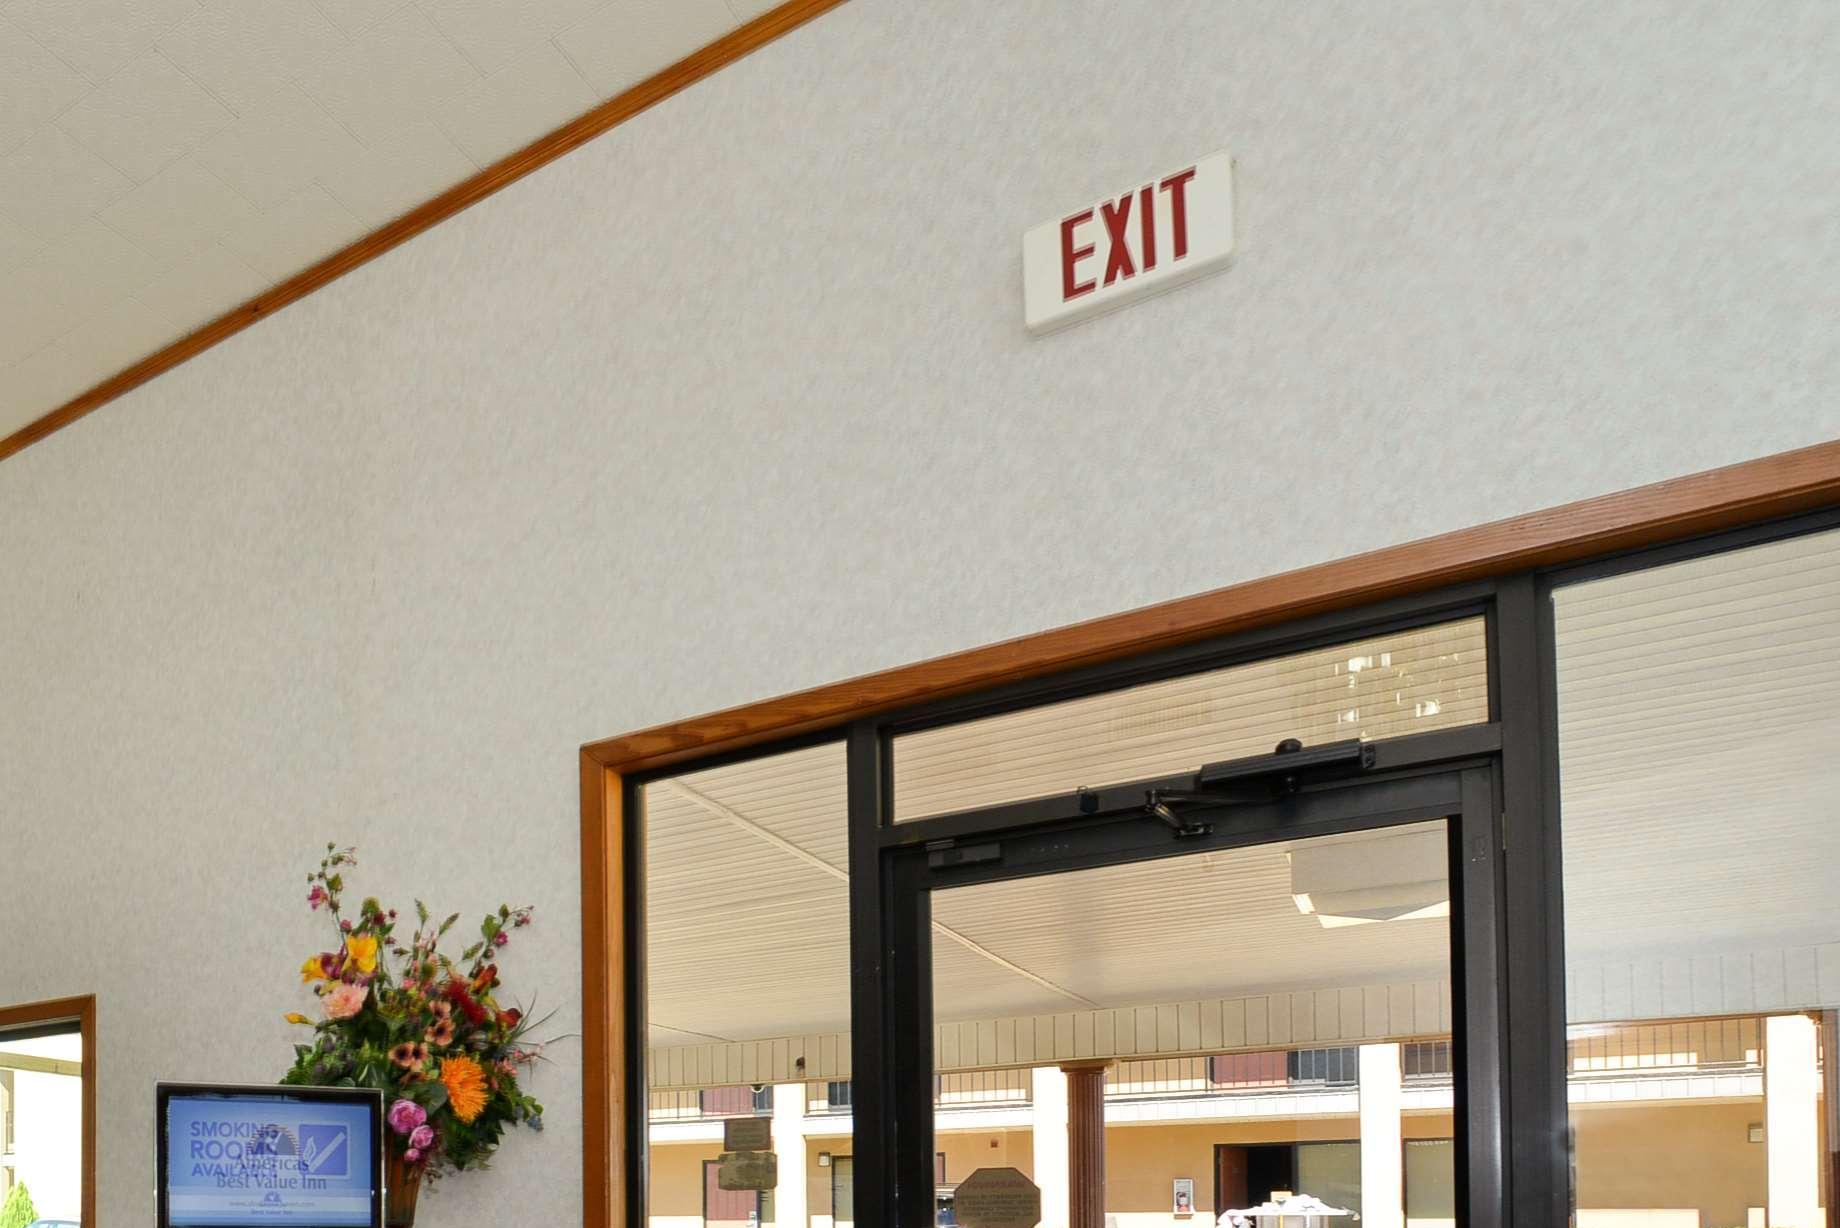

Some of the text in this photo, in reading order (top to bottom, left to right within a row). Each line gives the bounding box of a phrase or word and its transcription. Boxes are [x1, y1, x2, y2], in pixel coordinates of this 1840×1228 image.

[1060, 165, 1196, 302] EXIT
[235, 1157, 309, 1172] Americas
[216, 1172, 327, 1189] Best Value Inn
